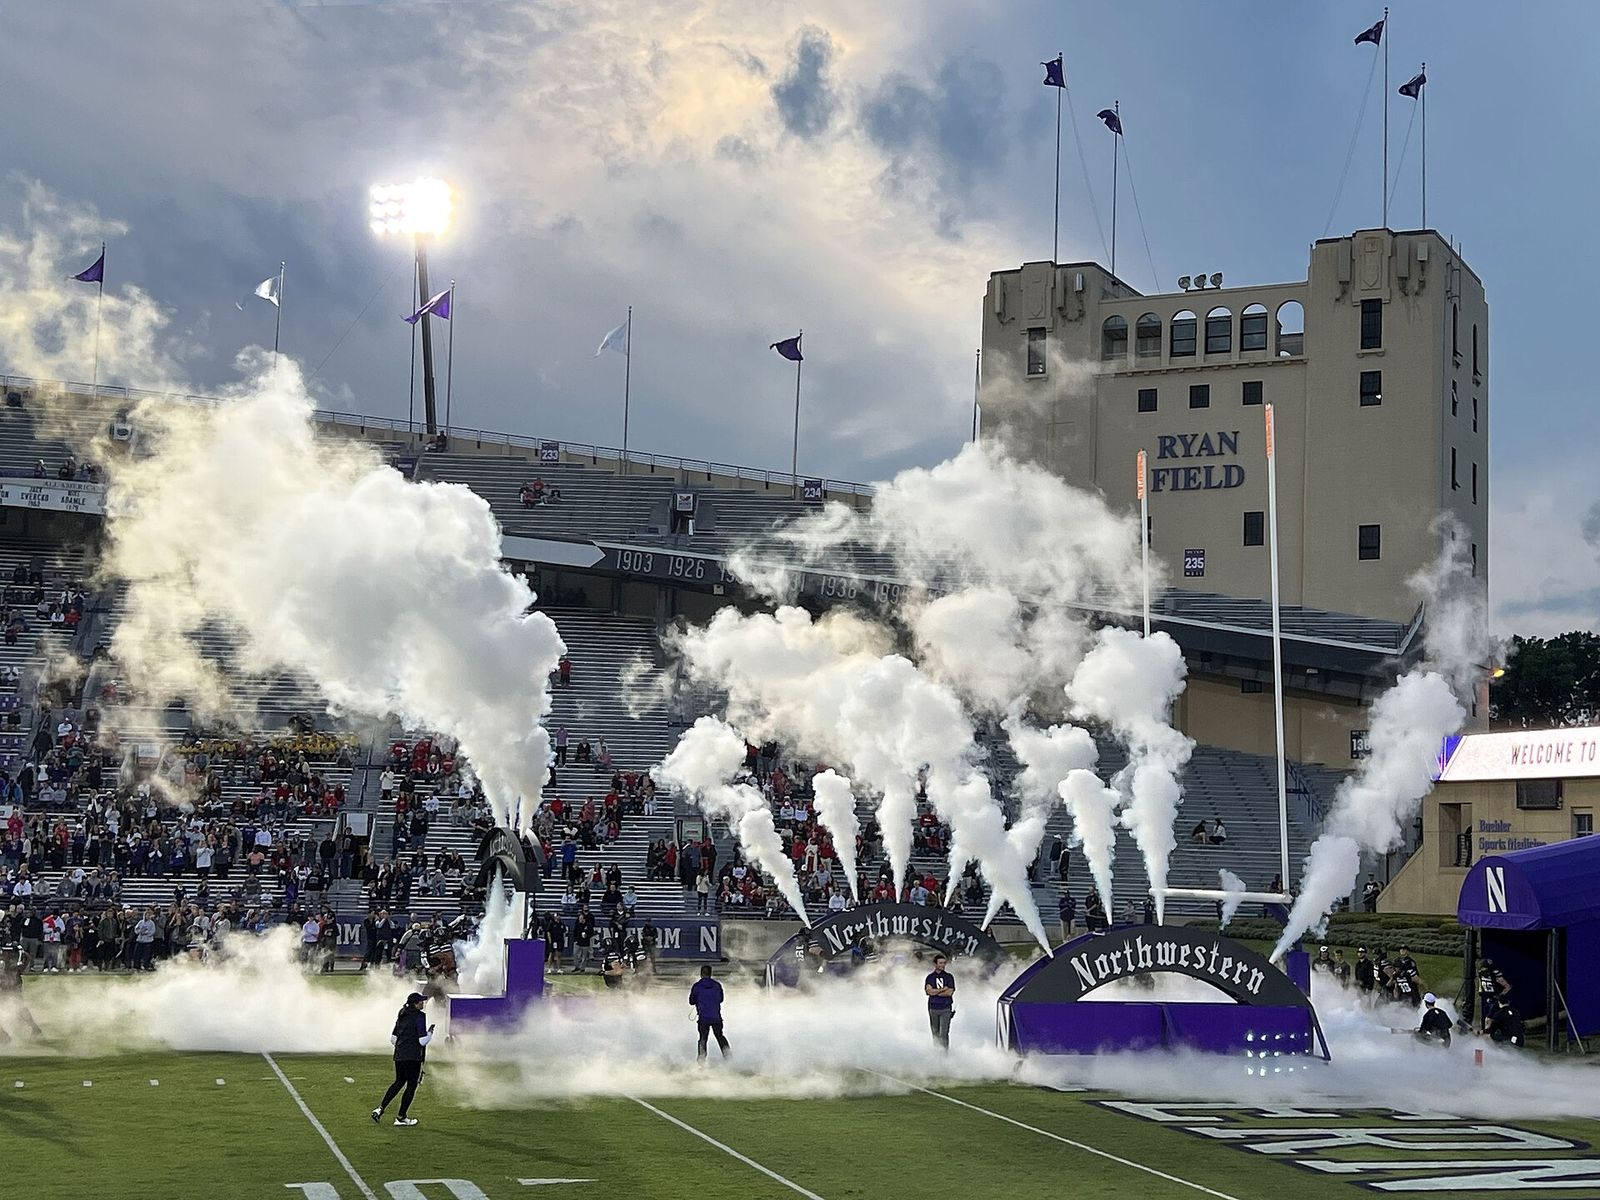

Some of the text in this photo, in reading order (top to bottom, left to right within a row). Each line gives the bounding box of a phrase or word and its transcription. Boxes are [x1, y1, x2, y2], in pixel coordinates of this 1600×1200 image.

[541, 450, 559, 460] 233
[1157, 431, 1240, 459] RYAN
[1151, 464, 1245, 492] FIELD
[805, 488, 821, 498] 234
[616, 550, 653, 573] 1903
[668, 556, 705, 579] 1926
[1185, 557, 1204, 569] 235
[1511, 740, 1597, 765] WELCOME TO
[1479, 837, 1507, 853] Sports
[1485, 867, 1507, 913] N
[699, 926, 718, 952] N
[823, 910, 980, 957] Northwestern
[1070, 934, 1266, 995] Northwestern
[935, 977, 944, 990] N
